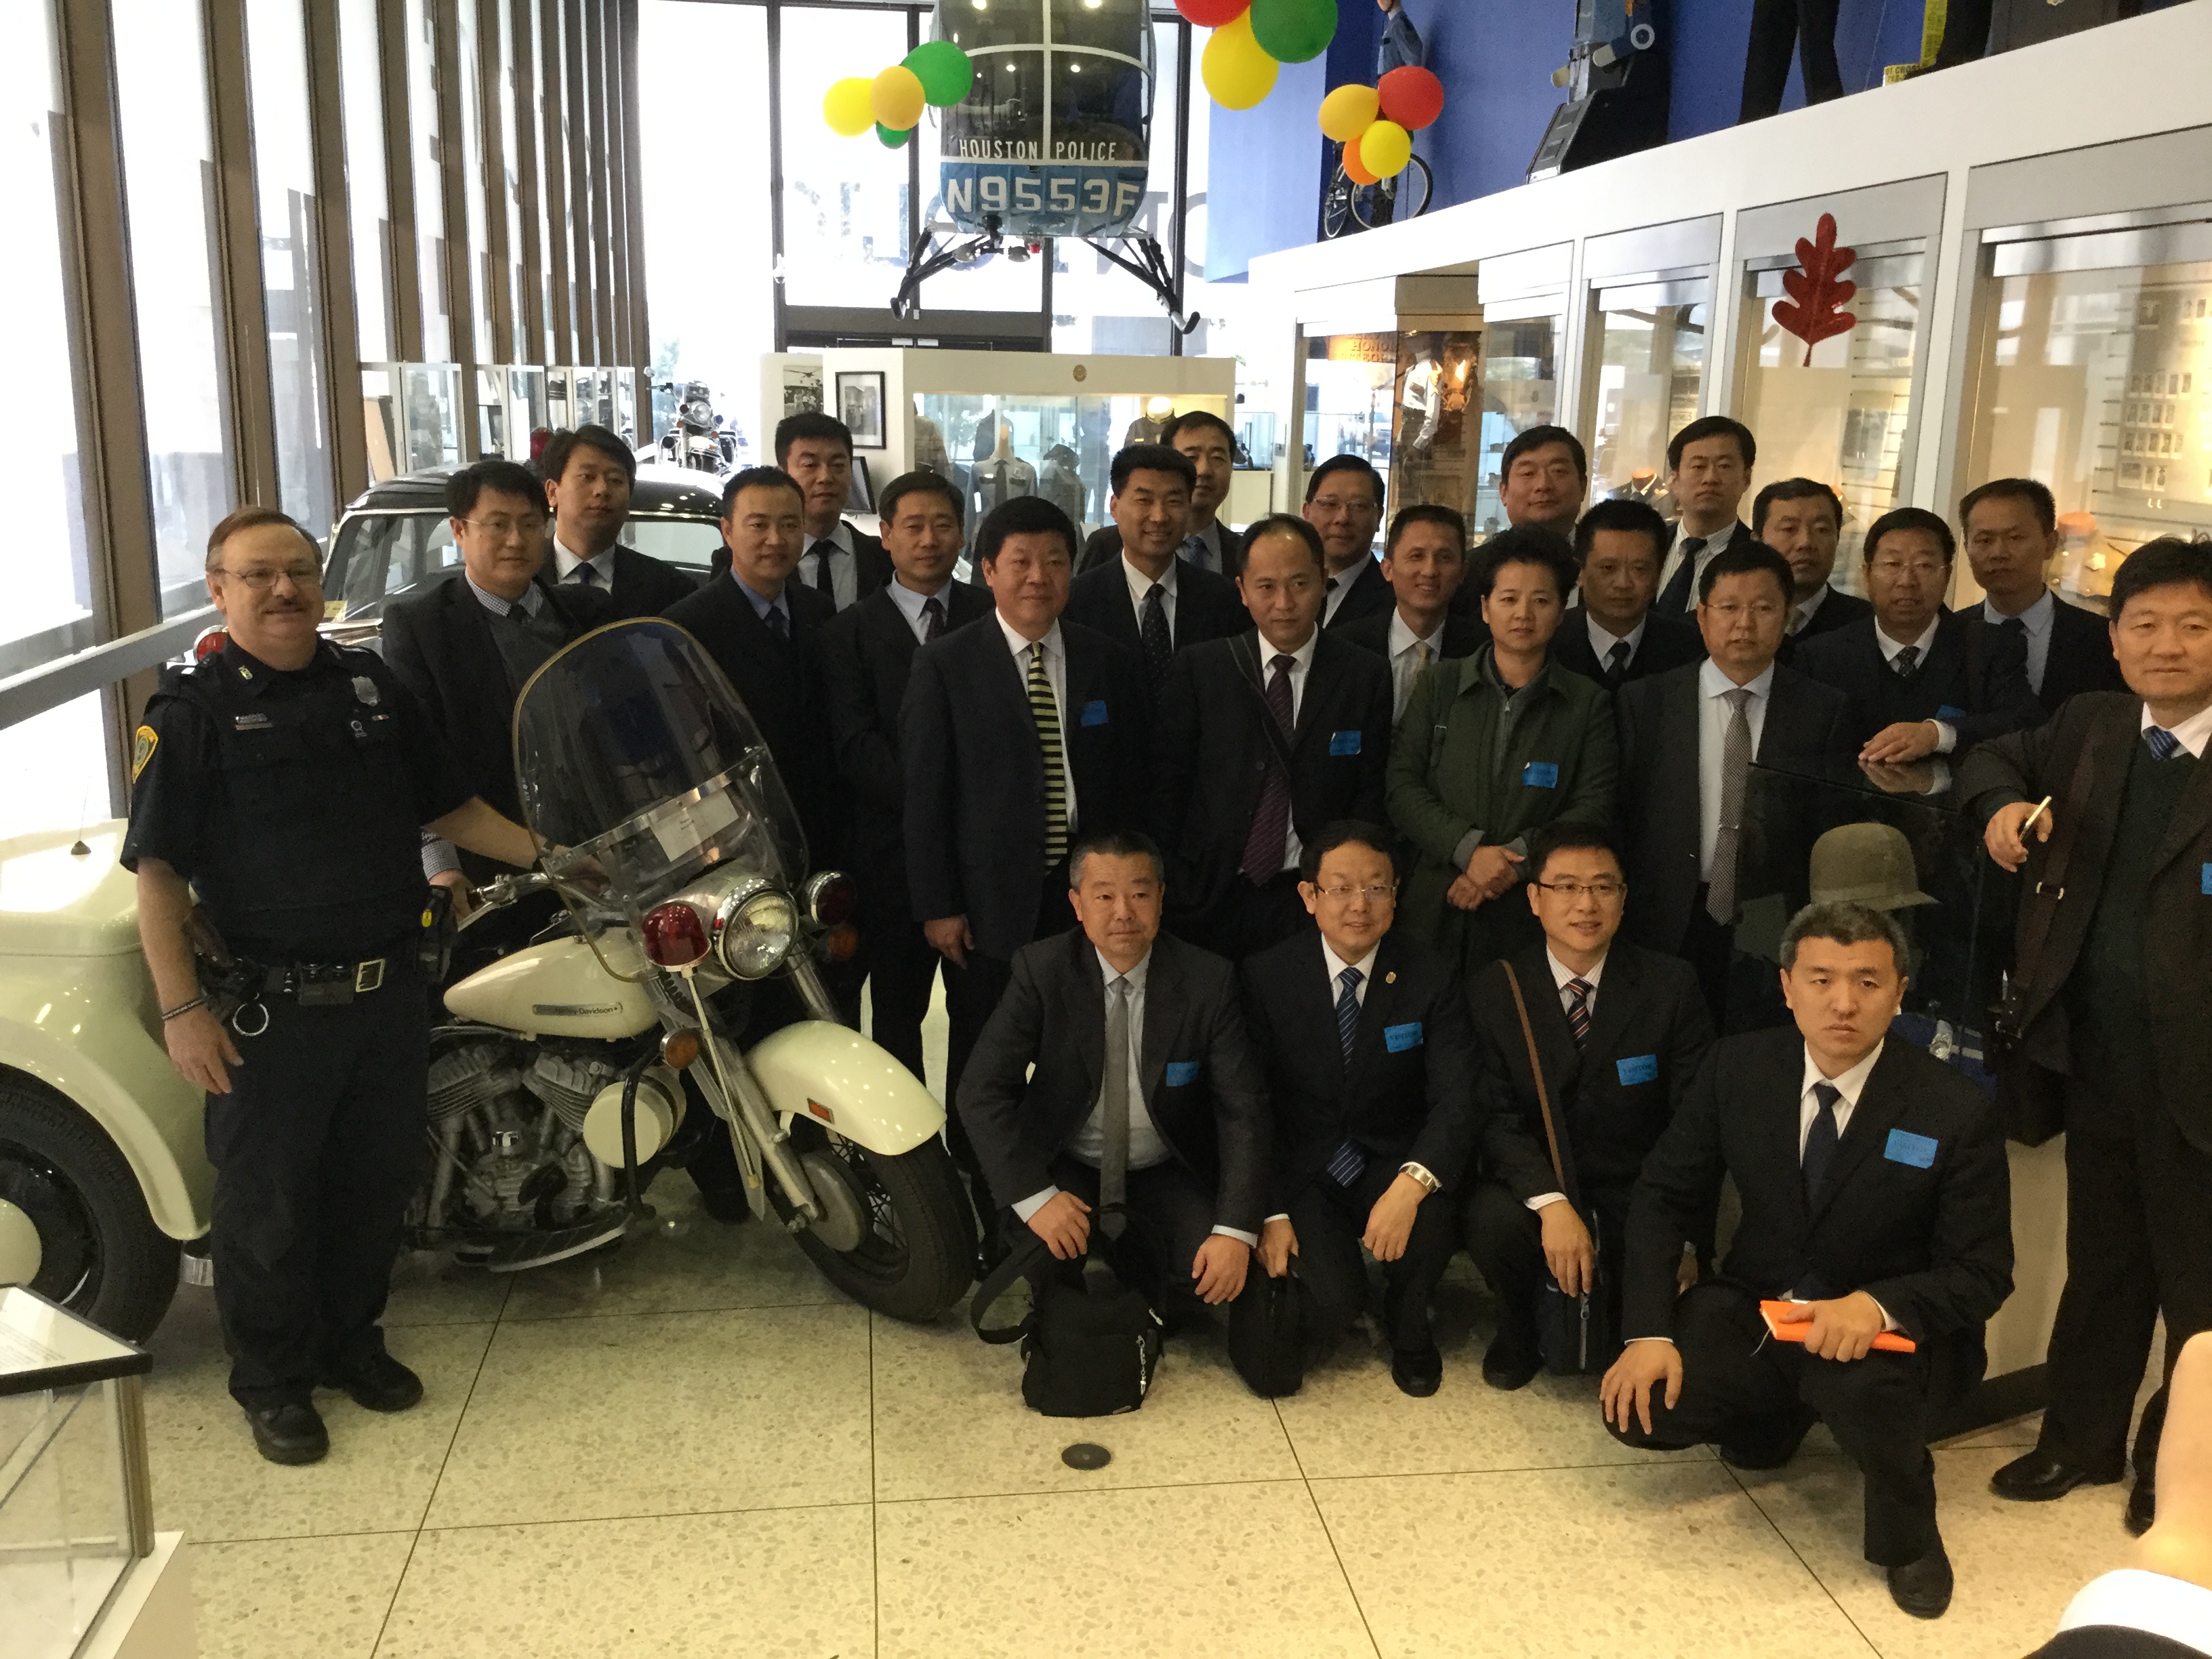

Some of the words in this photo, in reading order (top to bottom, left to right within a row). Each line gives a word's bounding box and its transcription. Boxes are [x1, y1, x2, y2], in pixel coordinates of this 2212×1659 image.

[960, 139, 1038, 160] HOUSTON
[1056, 141, 1116, 160] POLICE
[947, 176, 1140, 216] N9553F
